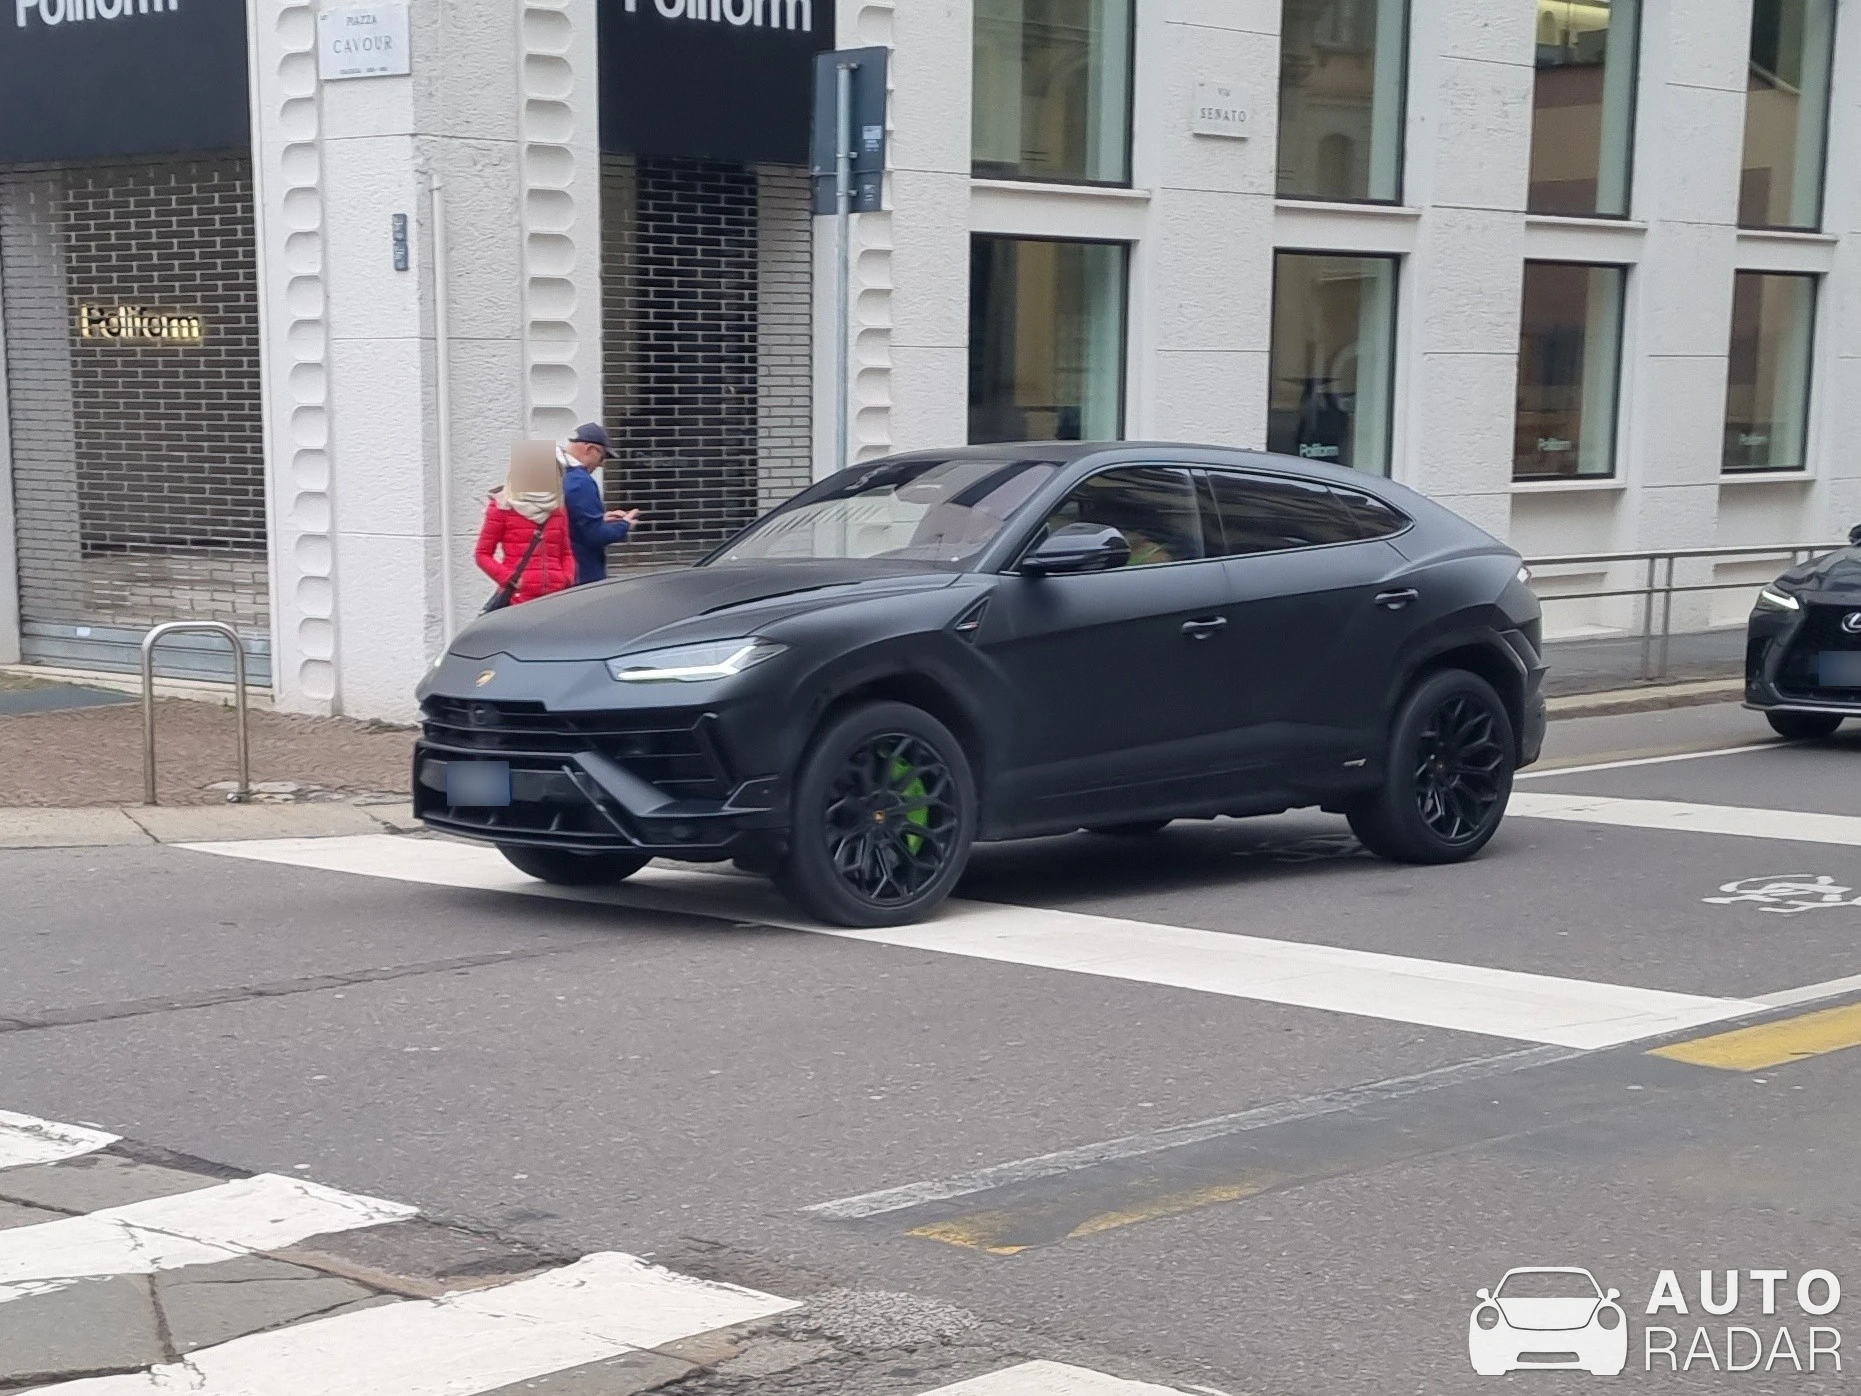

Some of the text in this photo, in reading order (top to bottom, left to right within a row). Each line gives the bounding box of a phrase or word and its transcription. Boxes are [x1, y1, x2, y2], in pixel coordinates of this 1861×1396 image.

[624, 0, 812, 32] oorm
[333, 35, 392, 54] CAVOUR
[1200, 107, 1247, 122] SENATO
[81, 304, 199, 338] Poliform
